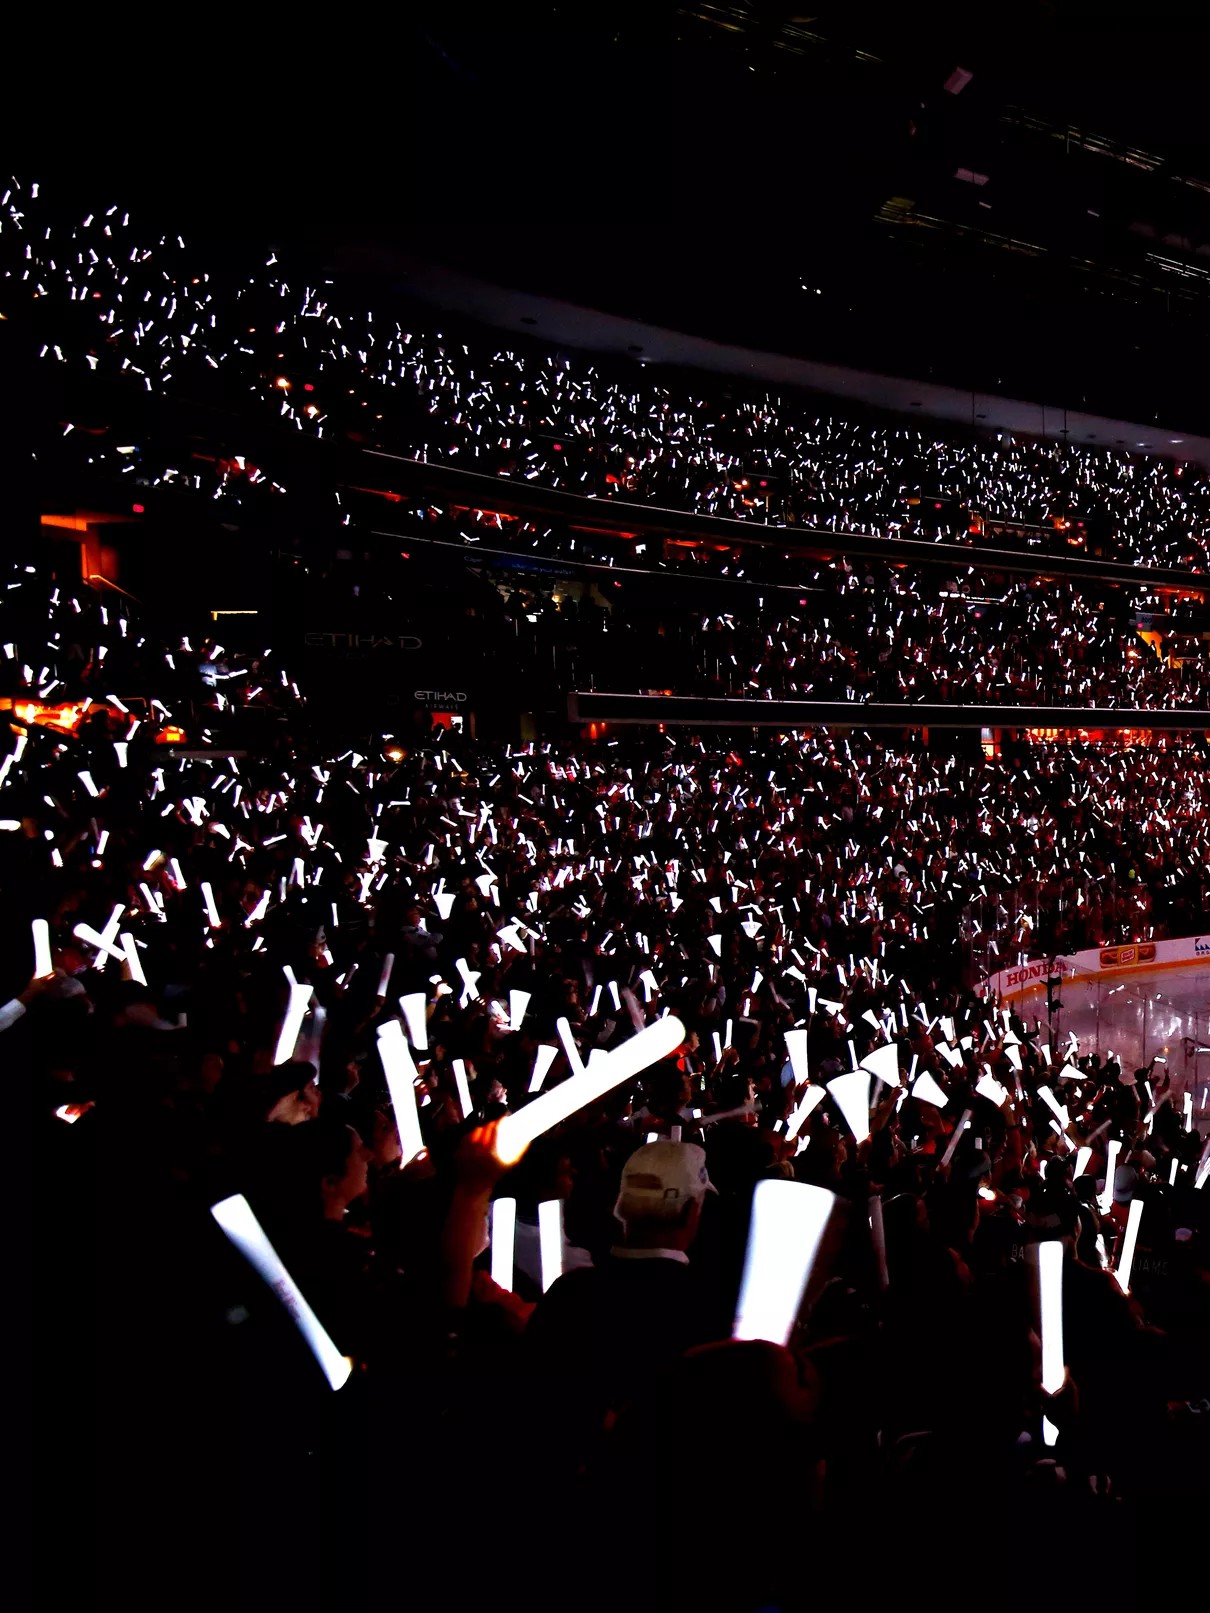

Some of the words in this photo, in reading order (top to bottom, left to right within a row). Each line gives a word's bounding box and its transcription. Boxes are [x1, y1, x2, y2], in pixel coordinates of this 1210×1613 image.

[304, 632, 424, 650] ETIHAD
[413, 690, 468, 702] ETIHAD
[1006, 961, 1067, 988] HONDA
